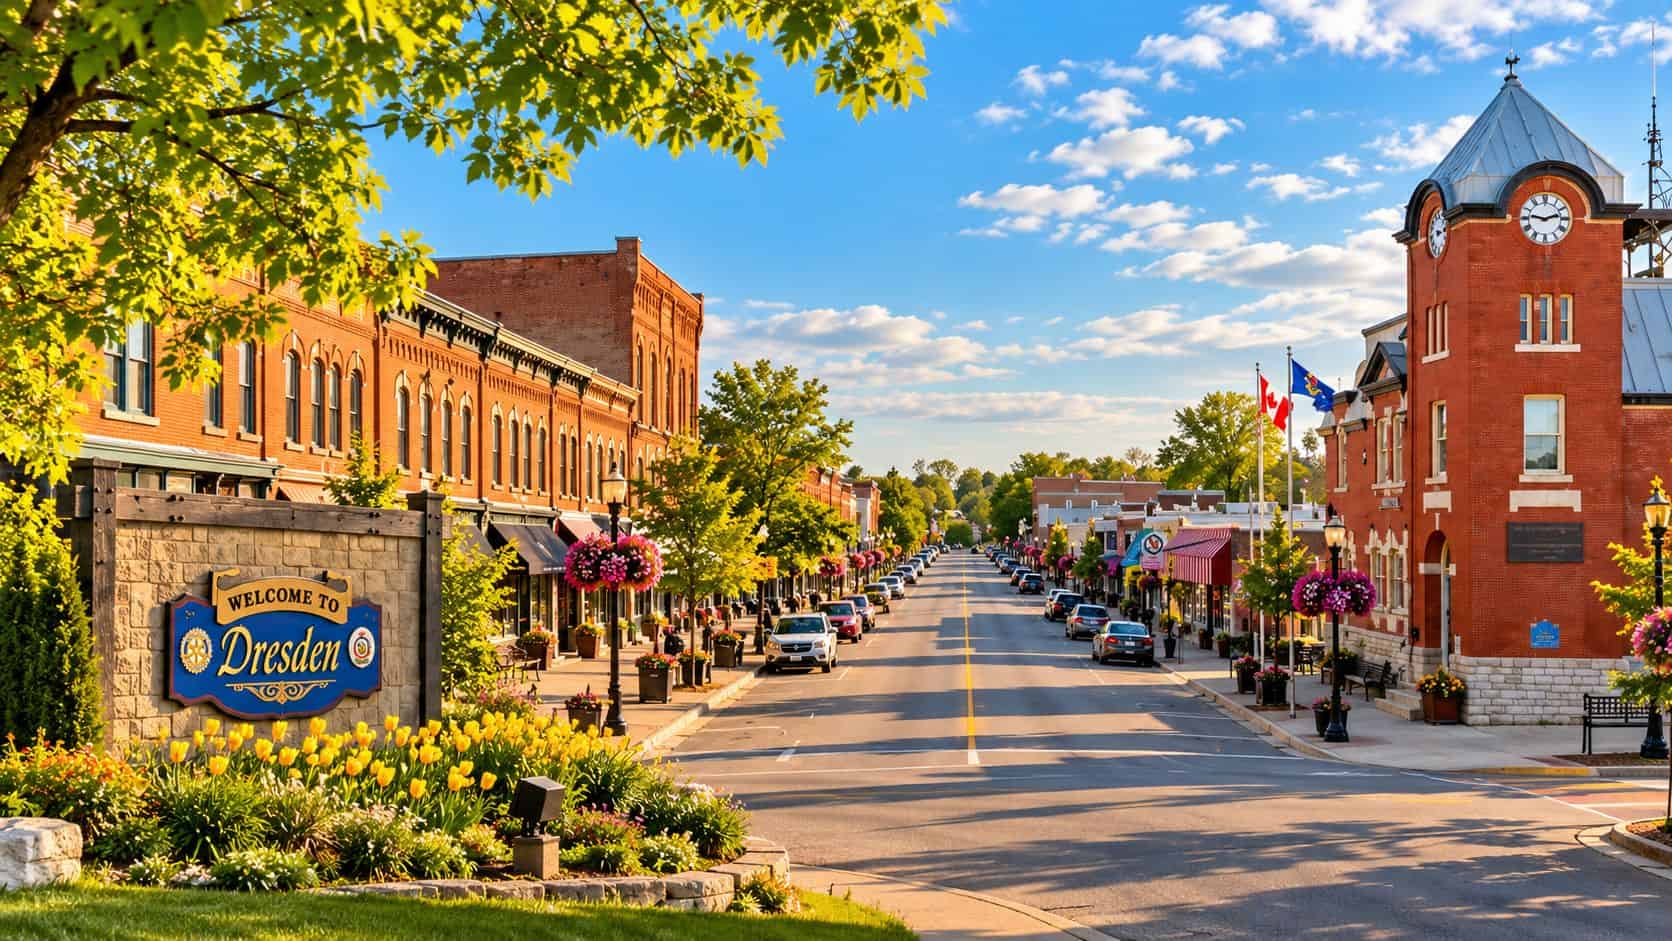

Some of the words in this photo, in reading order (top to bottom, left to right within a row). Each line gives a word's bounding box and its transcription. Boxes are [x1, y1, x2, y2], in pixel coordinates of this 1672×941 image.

[228, 588, 313, 612] WELCOME
[318, 593, 340, 613] TO
[217, 625, 341, 676] Dresden
